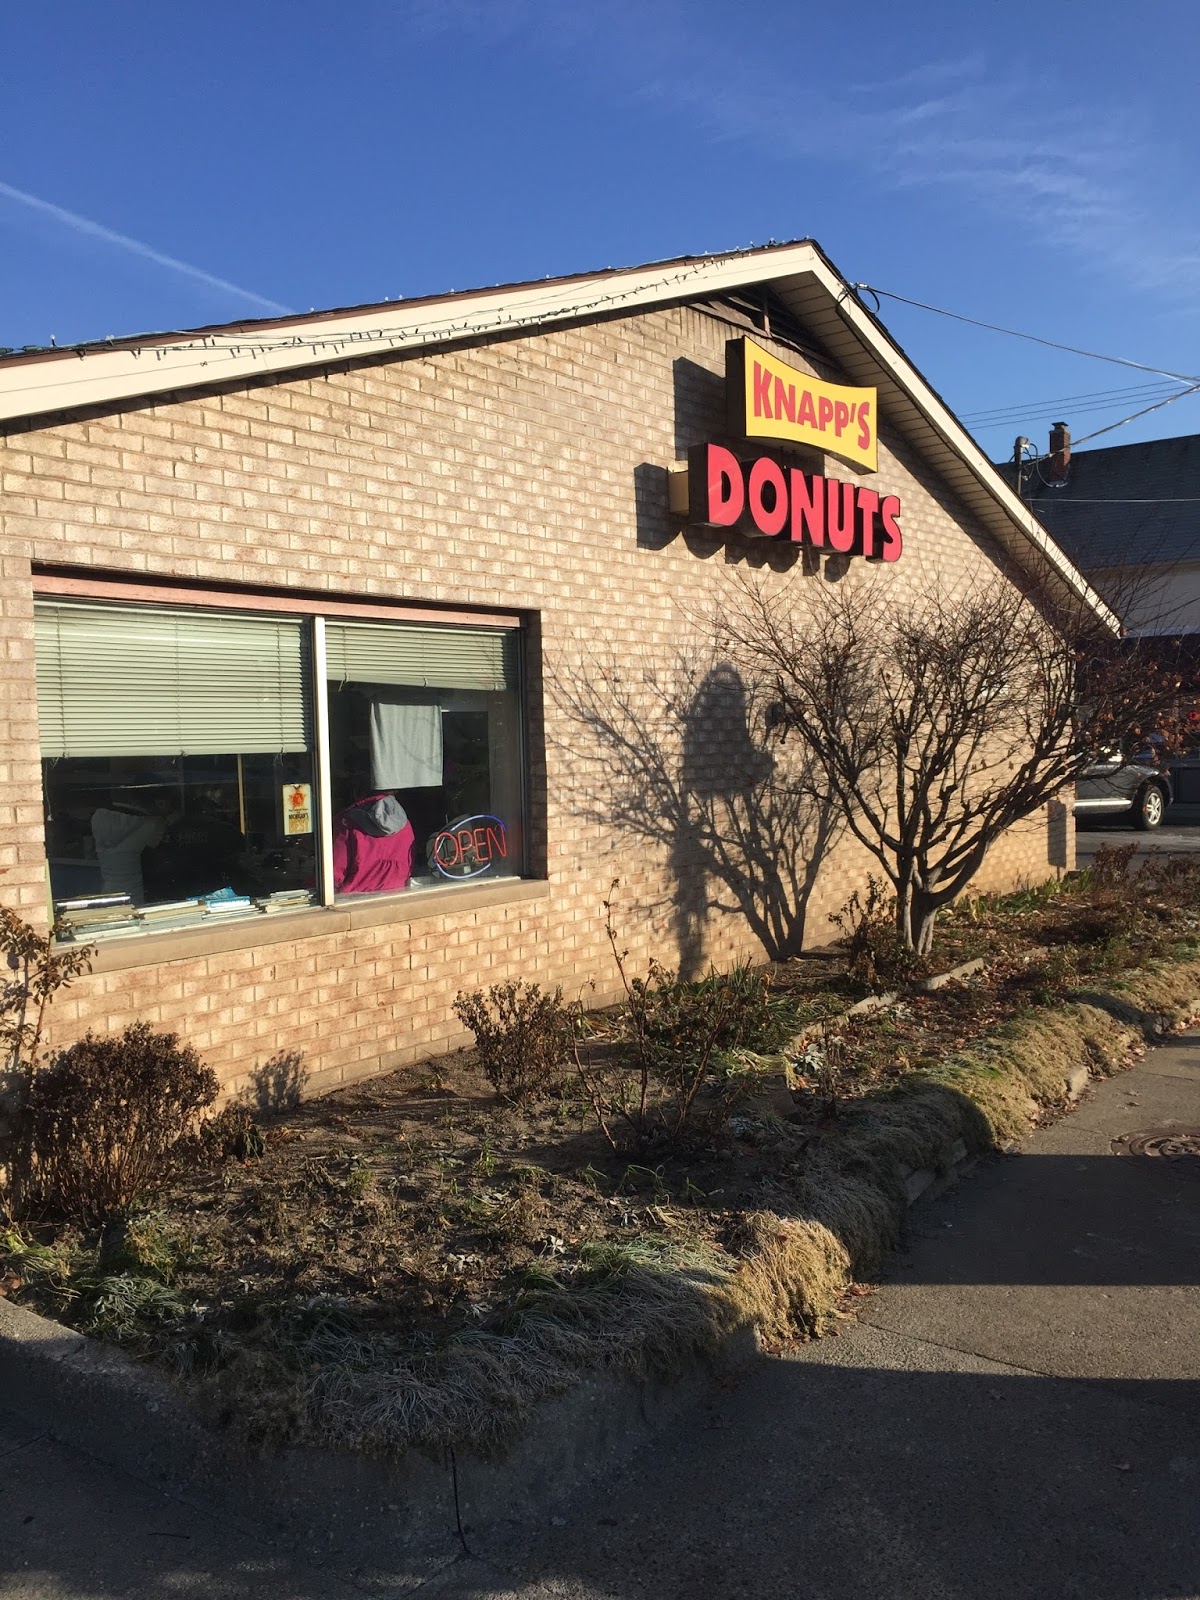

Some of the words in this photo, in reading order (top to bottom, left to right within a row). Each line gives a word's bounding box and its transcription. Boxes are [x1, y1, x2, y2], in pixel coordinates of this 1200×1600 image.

[753, 360, 870, 450] KNAPP'S
[707, 442, 903, 563] DONUTS
[434, 823, 507, 867] OPEN
